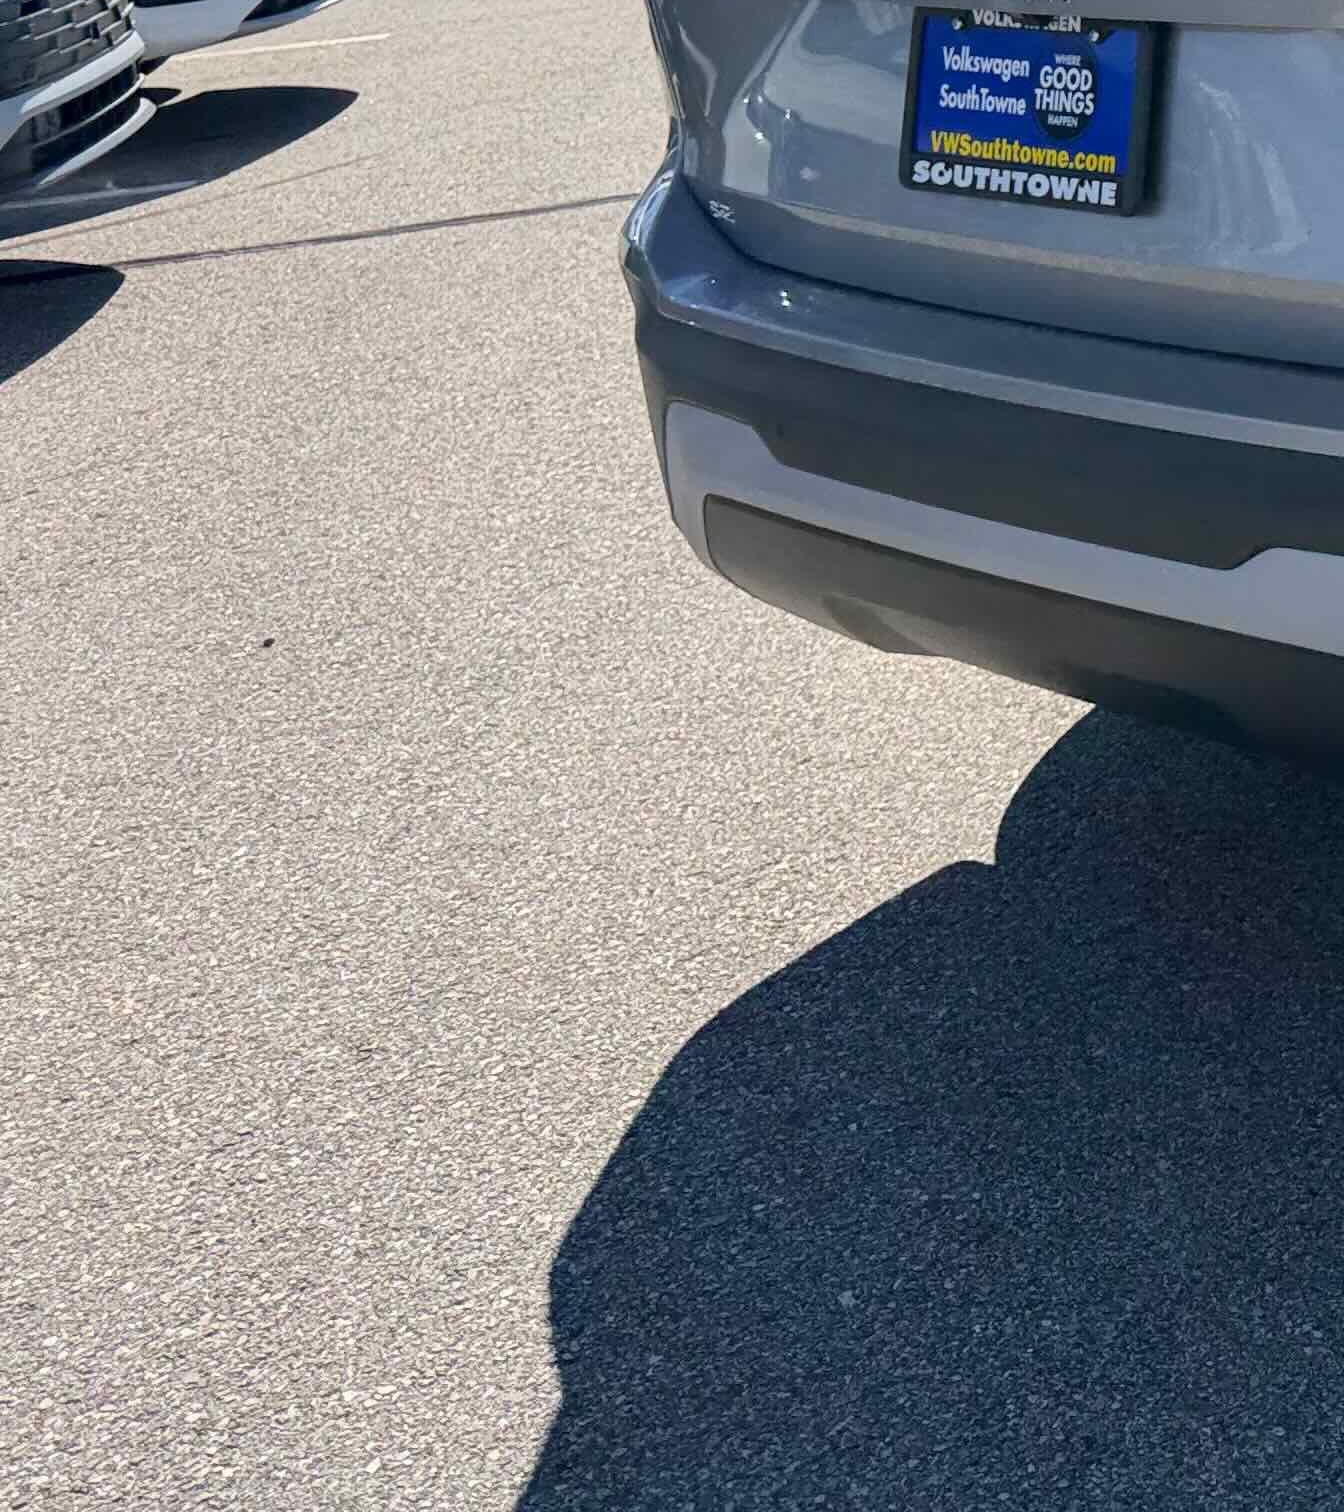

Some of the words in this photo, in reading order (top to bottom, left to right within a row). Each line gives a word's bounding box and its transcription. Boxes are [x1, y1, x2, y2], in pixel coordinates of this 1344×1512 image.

[942, 45, 1030, 82] Volkswagen
[1055, 53, 1081, 66] WHERE
[1039, 65, 1093, 91] GOOD
[939, 83, 1026, 116] SouthTowne
[1034, 88, 1095, 116] THINGS
[1047, 113, 1079, 128] HAPPEN
[930, 130, 1116, 175] VWSouthtowne.com
[912, 159, 1118, 207] SOUTHTOWNE
